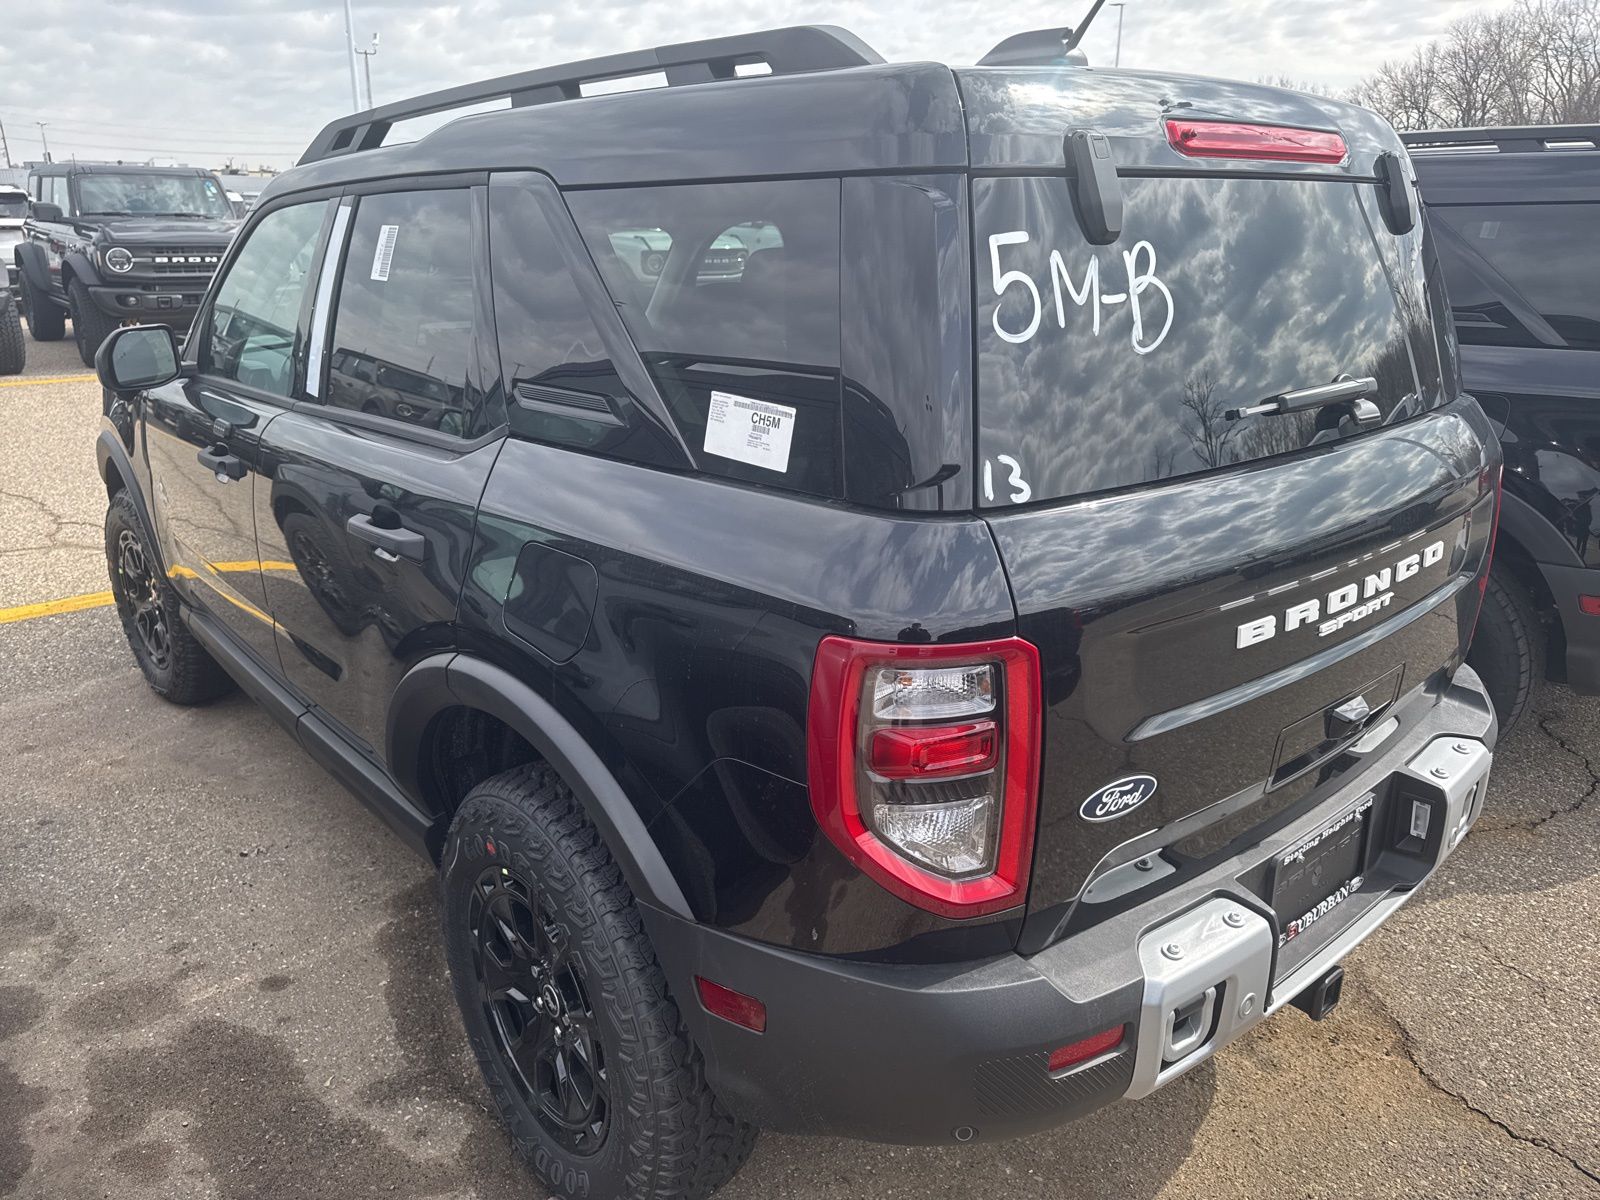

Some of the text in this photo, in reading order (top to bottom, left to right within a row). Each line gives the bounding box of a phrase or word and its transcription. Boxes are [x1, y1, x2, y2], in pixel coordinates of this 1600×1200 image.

[988, 230, 1175, 355] 5M-B
[751, 412, 781, 429] CH5M
[983, 454, 1031, 504] 13
[1236, 540, 1445, 649] BRONCO
[1318, 591, 1395, 637] SPORT
[1092, 780, 1148, 817] Ford
[1283, 836, 1321, 866] Sterling
[1287, 886, 1350, 941] SUBURBAN
